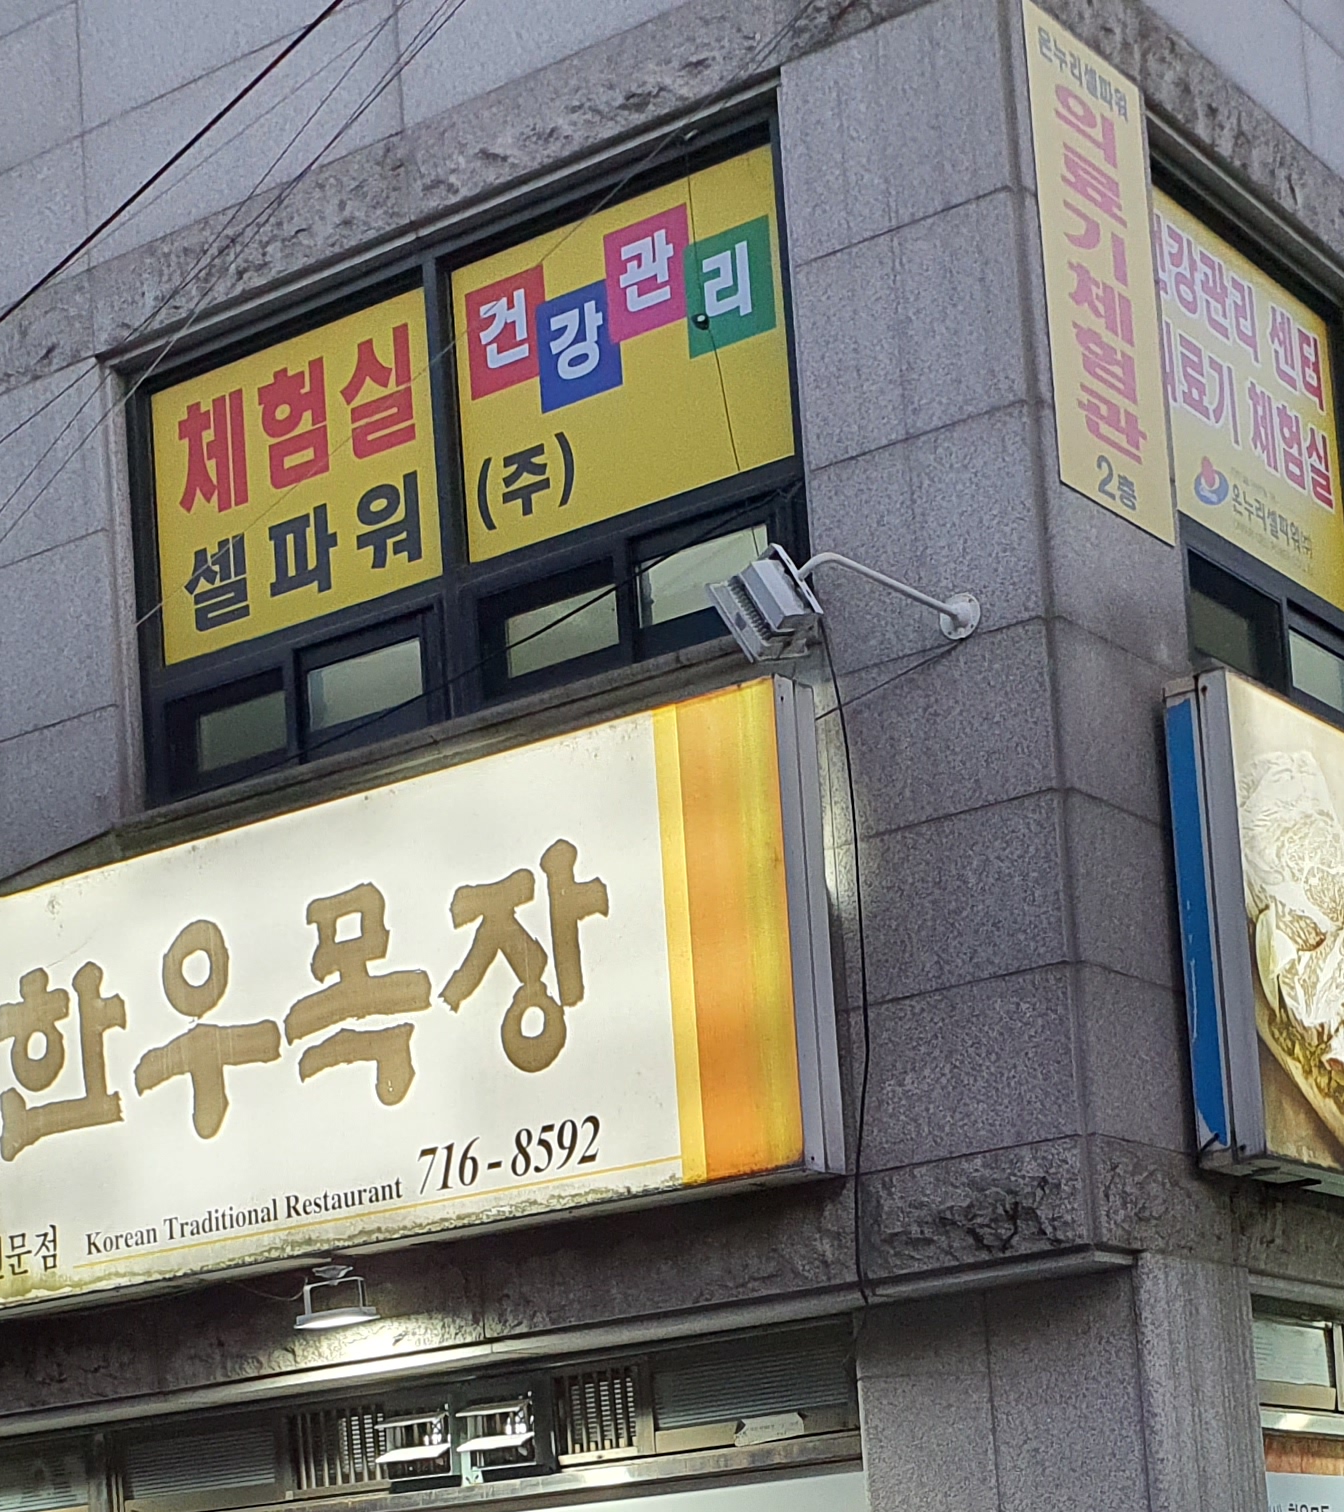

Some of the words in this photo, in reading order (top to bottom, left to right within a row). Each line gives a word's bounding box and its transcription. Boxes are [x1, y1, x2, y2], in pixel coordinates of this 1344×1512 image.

[478, 229, 756, 380] 건강관리
[1053, 83, 1148, 465] 의료기체험관
[177, 321, 417, 515] 체험실
[1268, 304, 1325, 415] 센터
[475, 432, 577, 532] (주)
[1096, 454, 1138, 512] 2층
[1247, 379, 1335, 512] 체험실
[183, 470, 424, 633] 셀파워
[415, 1114, 602, 1195] 716-8592
[84, 1223, 158, 1256] Korean
[163, 1197, 279, 1243] Traditional
[284, 1176, 403, 1221] Restaurant
